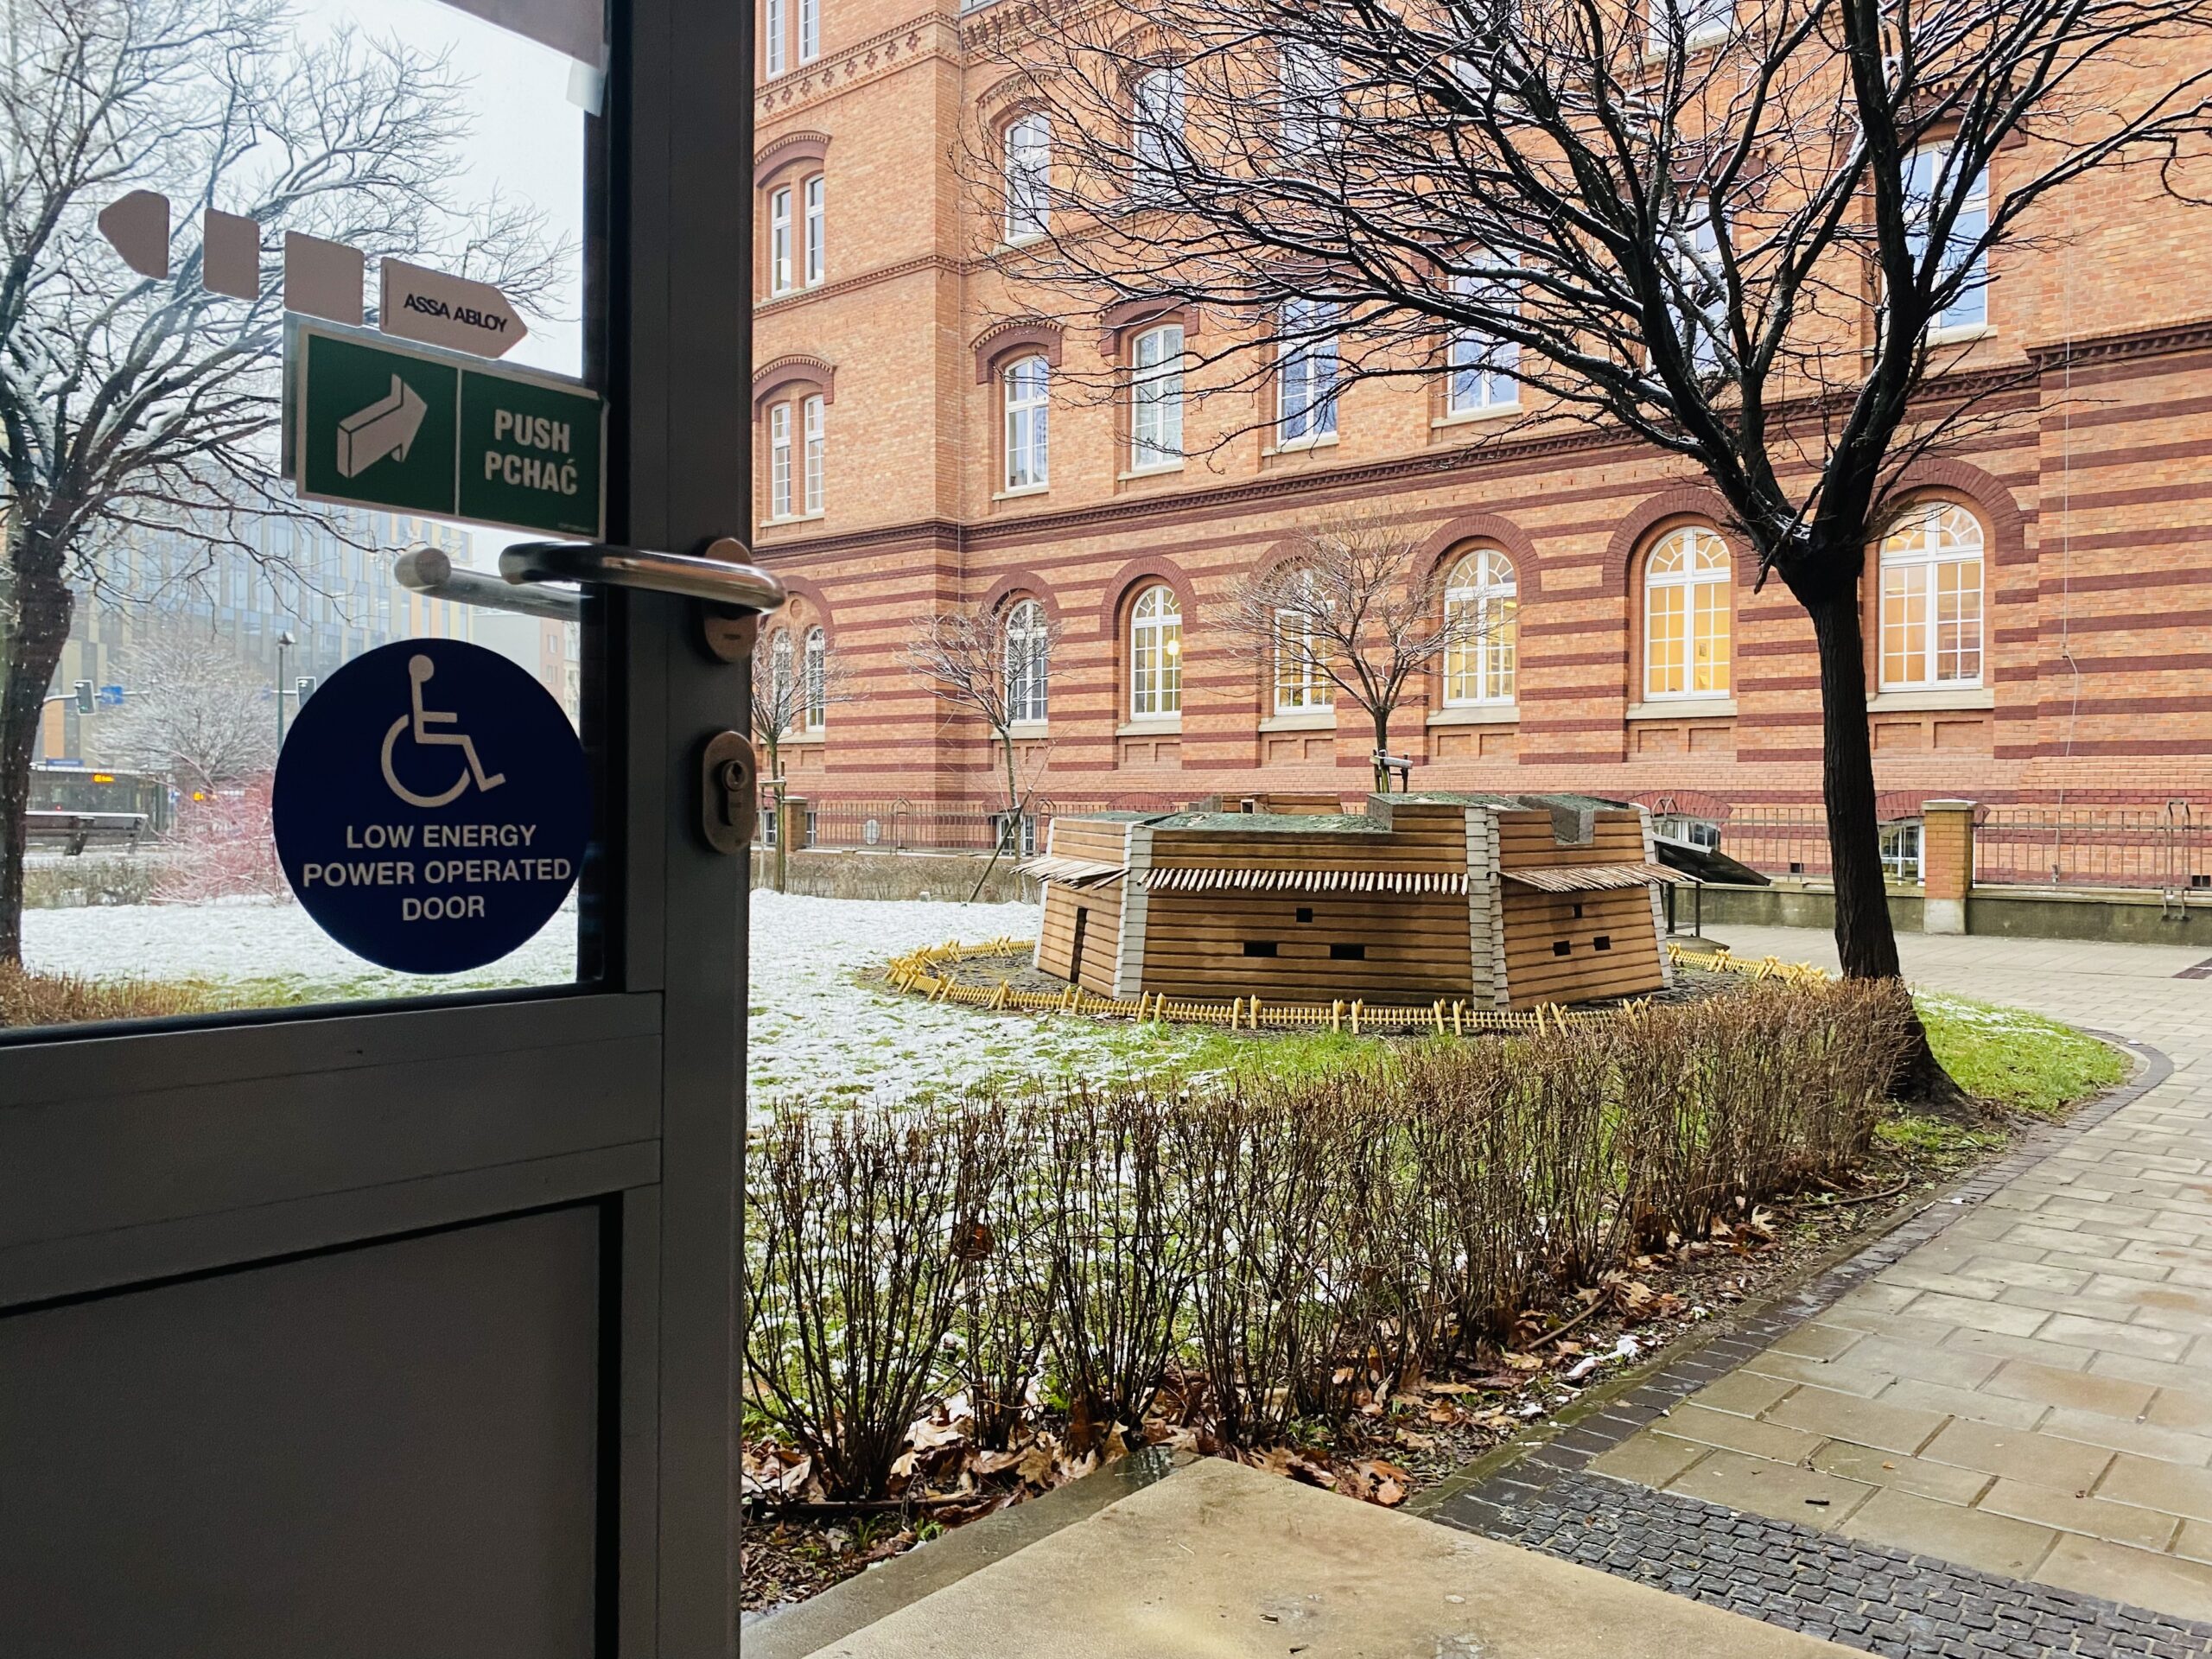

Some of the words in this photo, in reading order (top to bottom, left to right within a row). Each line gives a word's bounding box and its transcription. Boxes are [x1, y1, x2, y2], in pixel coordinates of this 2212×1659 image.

[404, 294, 450, 320] ASSA
[454, 307, 508, 333] ABLOY
[494, 409, 570, 454] PUSH
[485, 451, 578, 495] PCHAĆ
[346, 825, 414, 849] LOW
[423, 824, 537, 848] ENERGY
[303, 861, 415, 887] POWER
[424, 859, 571, 884] OPERATED
[403, 895, 485, 921] DOOR
